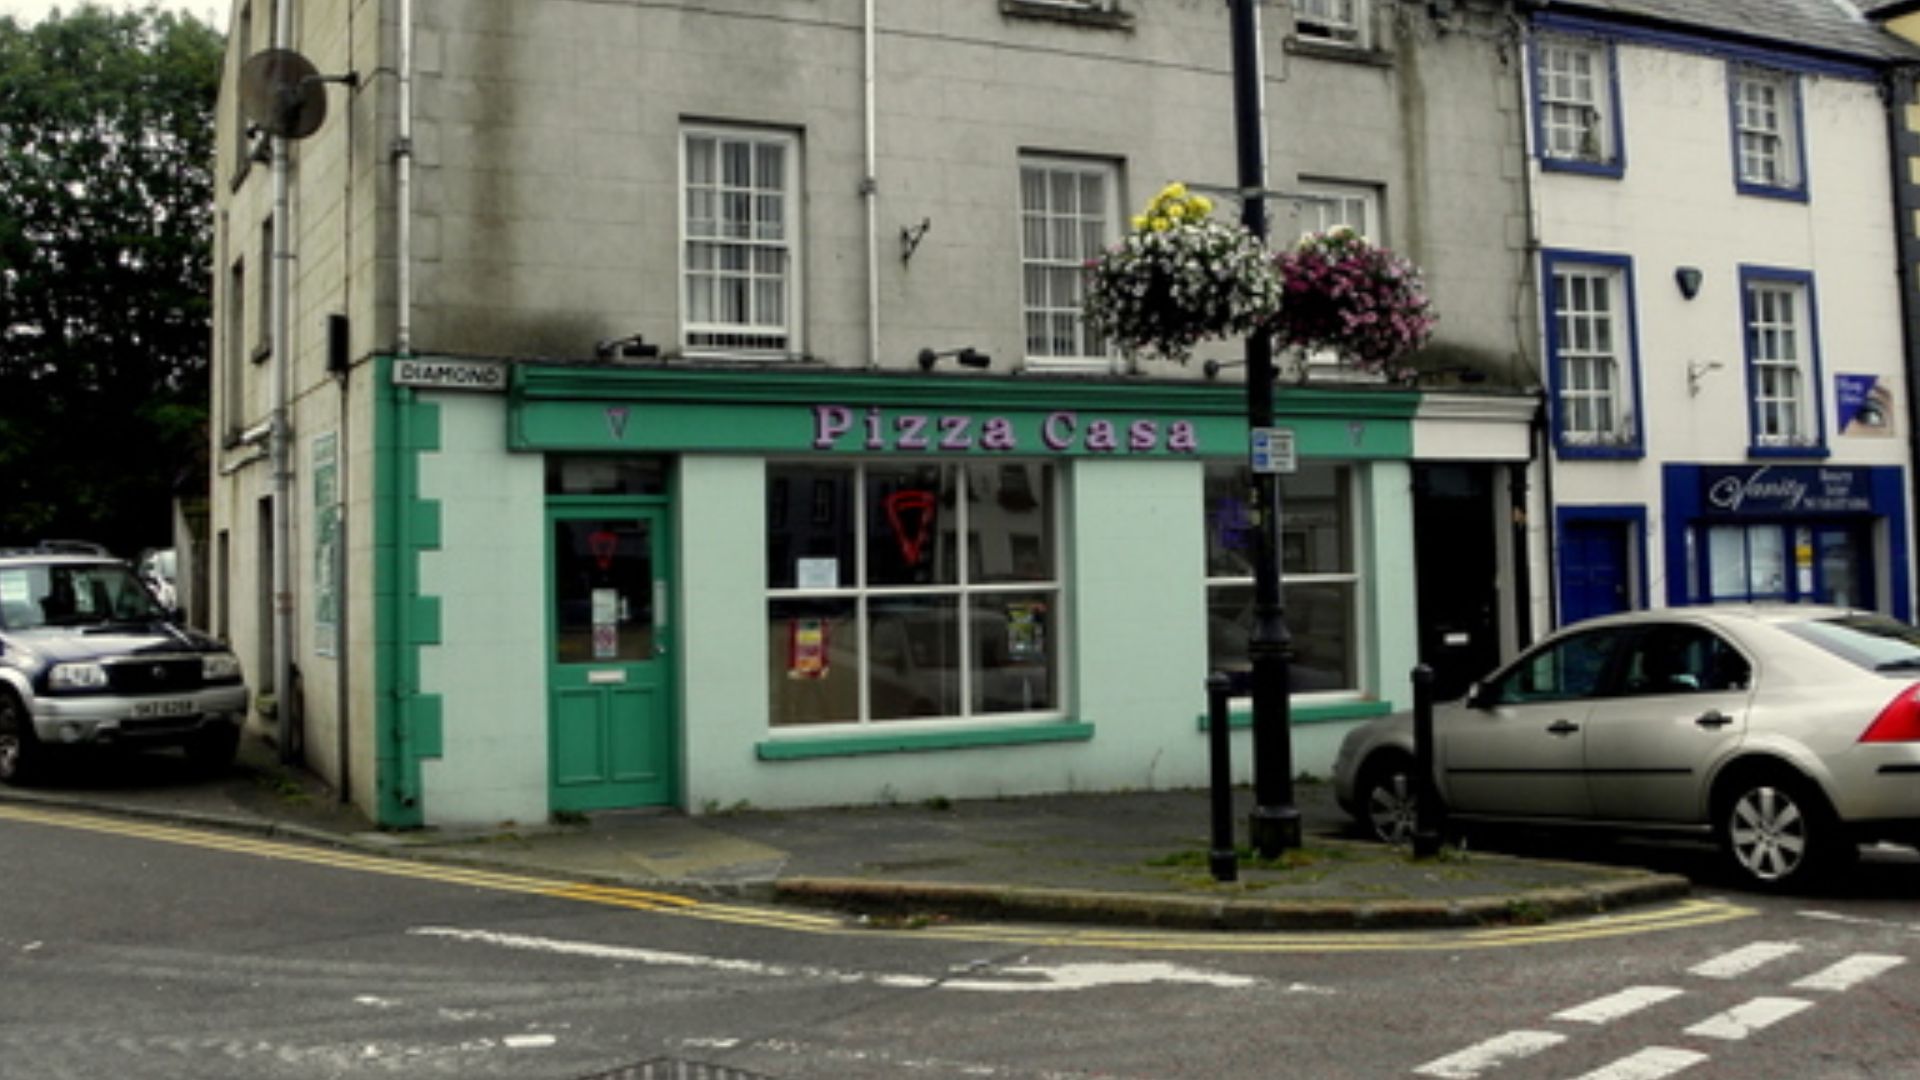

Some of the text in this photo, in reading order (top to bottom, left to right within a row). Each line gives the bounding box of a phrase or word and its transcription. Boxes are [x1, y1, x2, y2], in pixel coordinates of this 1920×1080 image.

[401, 363, 499, 383] DIAMOND
[813, 405, 1198, 452] Pizza Casa
[1708, 464, 1807, 512] Vanity
